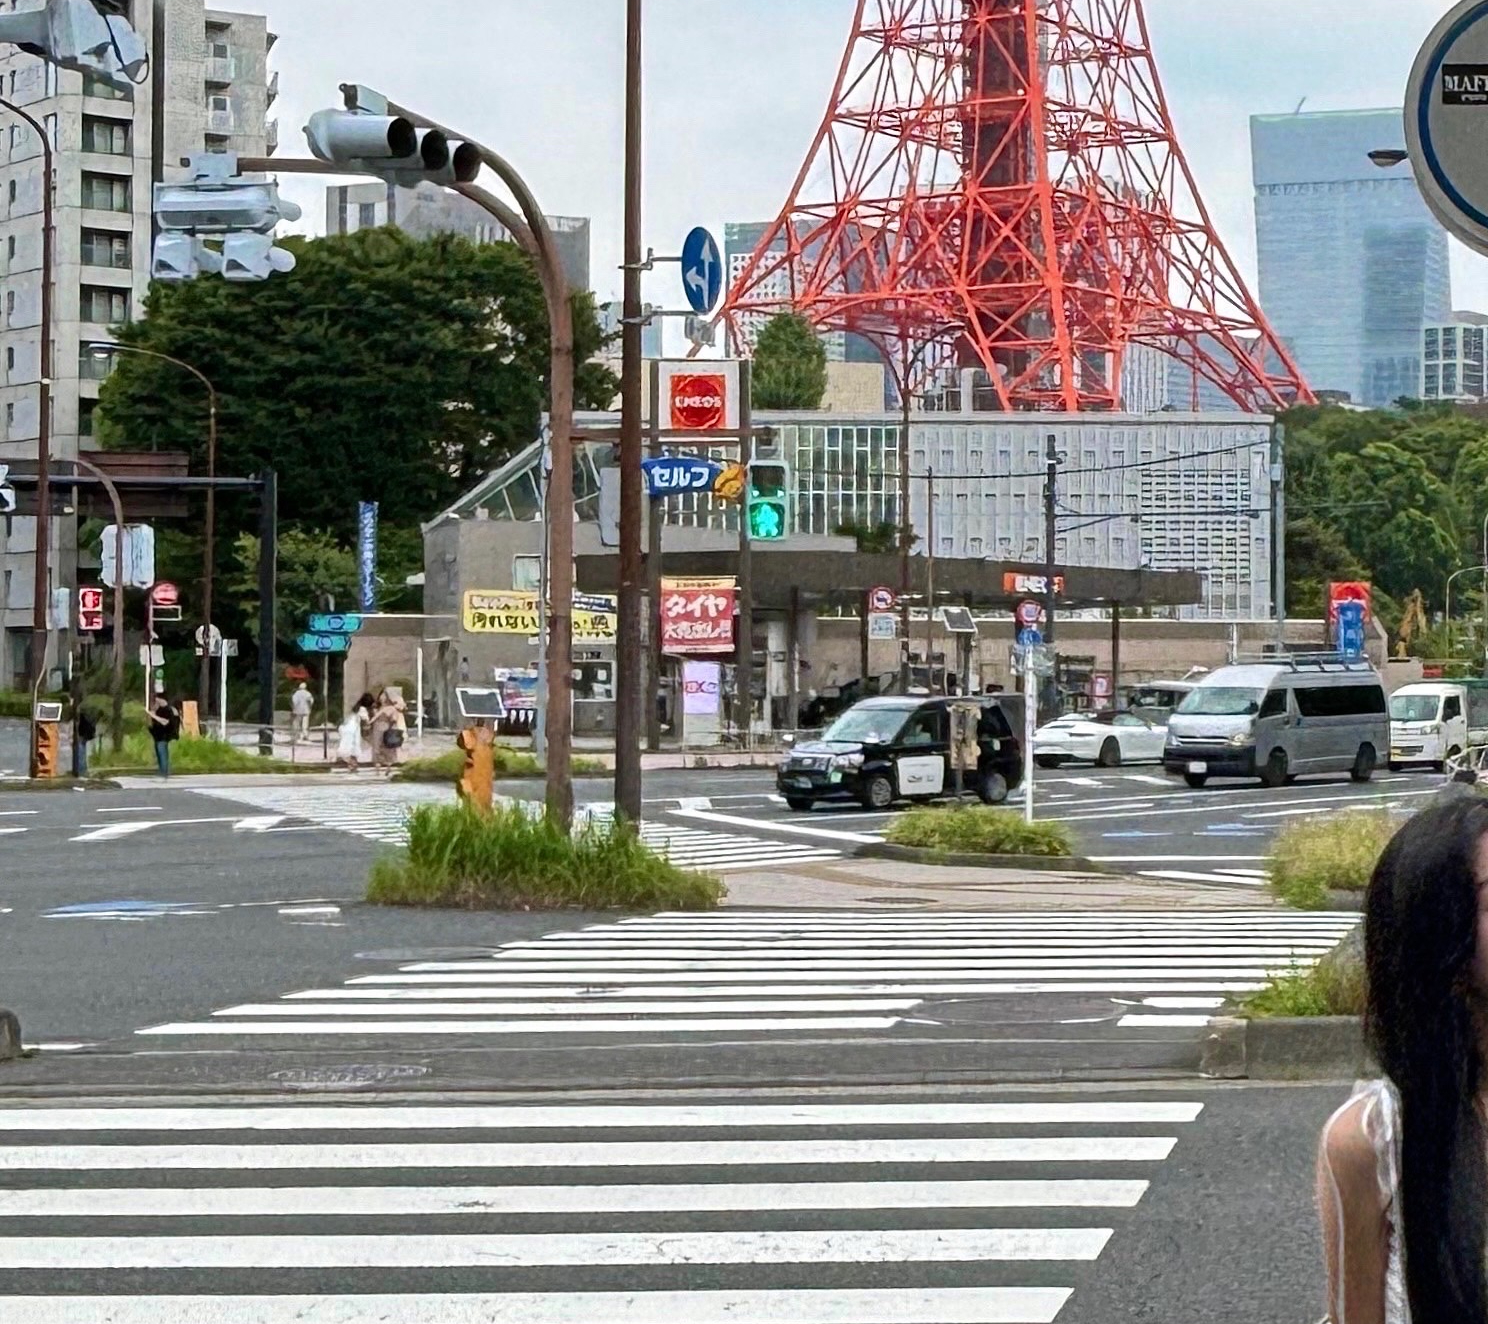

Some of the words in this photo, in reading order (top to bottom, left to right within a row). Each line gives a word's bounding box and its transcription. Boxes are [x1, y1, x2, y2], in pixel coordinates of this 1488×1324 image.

[650, 465, 709, 488] セルフ
[665, 593, 728, 618] タイヤ
